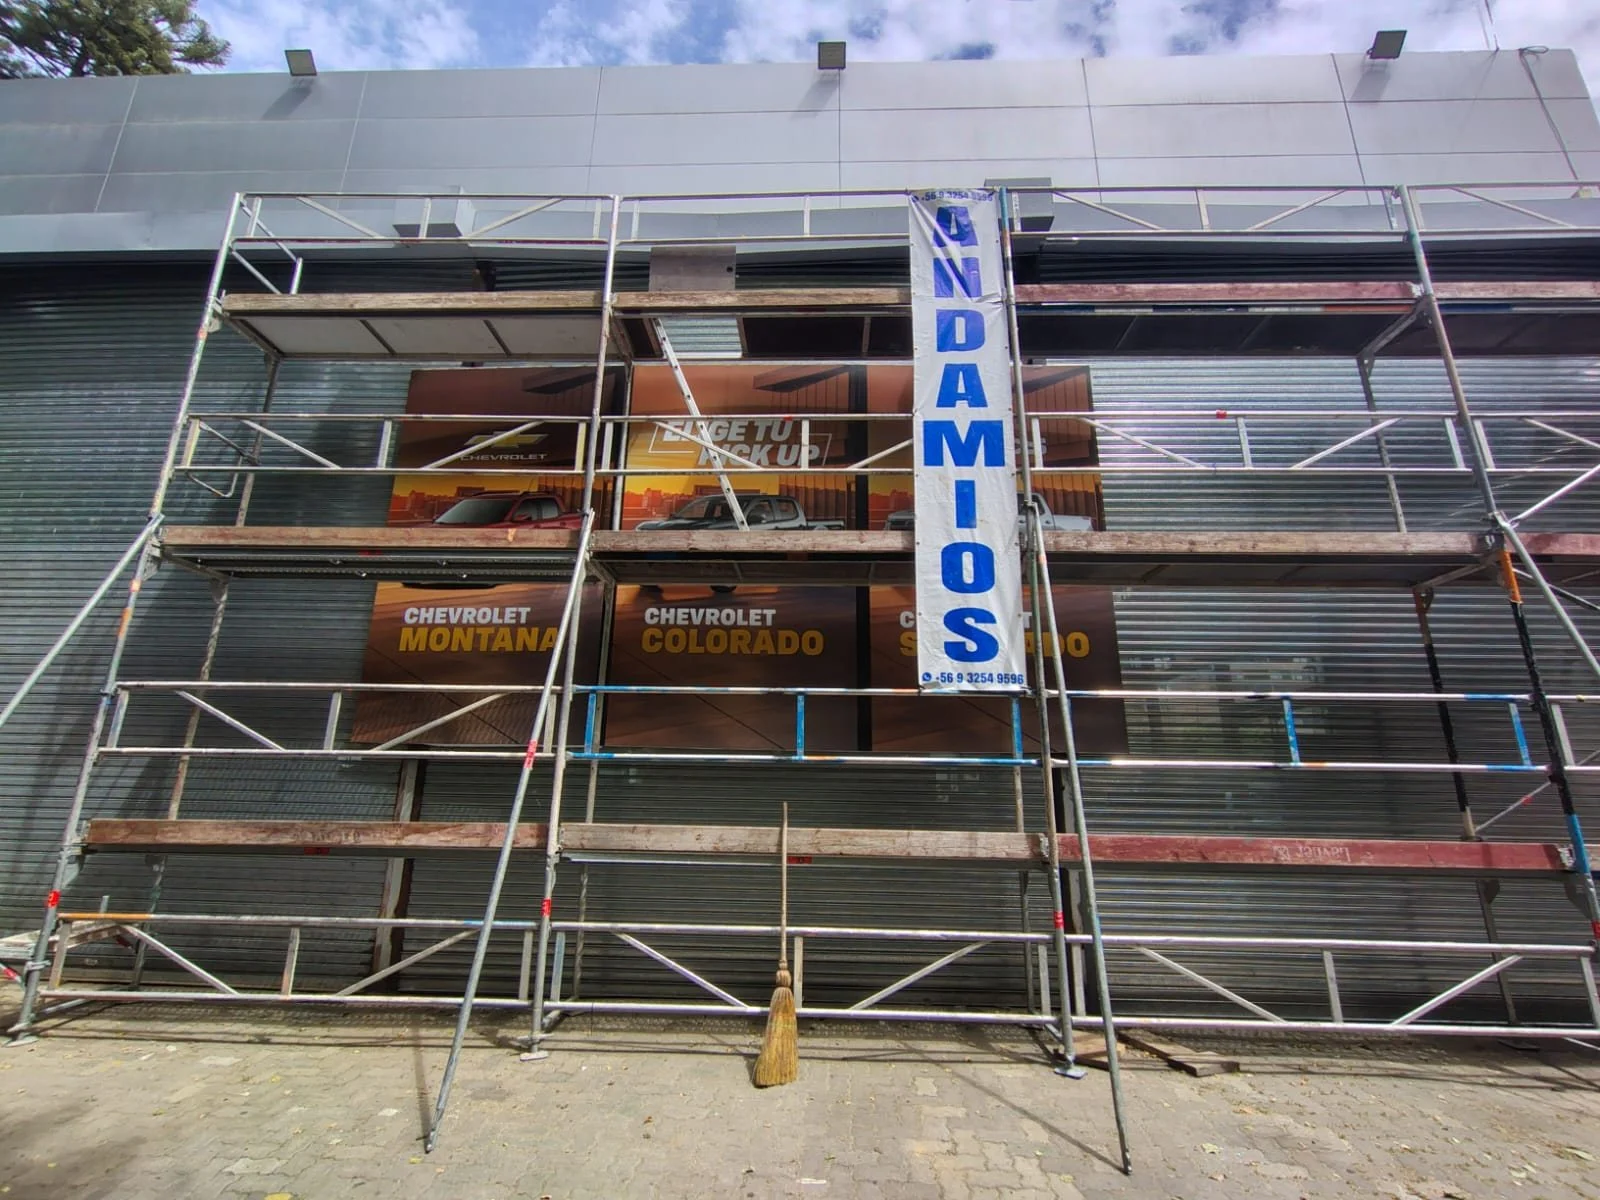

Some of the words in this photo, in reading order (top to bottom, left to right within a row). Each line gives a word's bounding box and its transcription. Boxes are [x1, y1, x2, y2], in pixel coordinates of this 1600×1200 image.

[754, 419, 794, 442] TU
[923, 206, 1006, 663] ANDAMIOS
[460, 453, 548, 462] CHEVROLET
[404, 607, 531, 624] CHEVROLET
[644, 607, 776, 626] CHEVROLET
[399, 627, 559, 652] MONTANA
[641, 628, 824, 656] COLORADO
[956, 672, 964, 684] 9
[967, 672, 994, 684] 3254
[997, 673, 1025, 685] 9596
